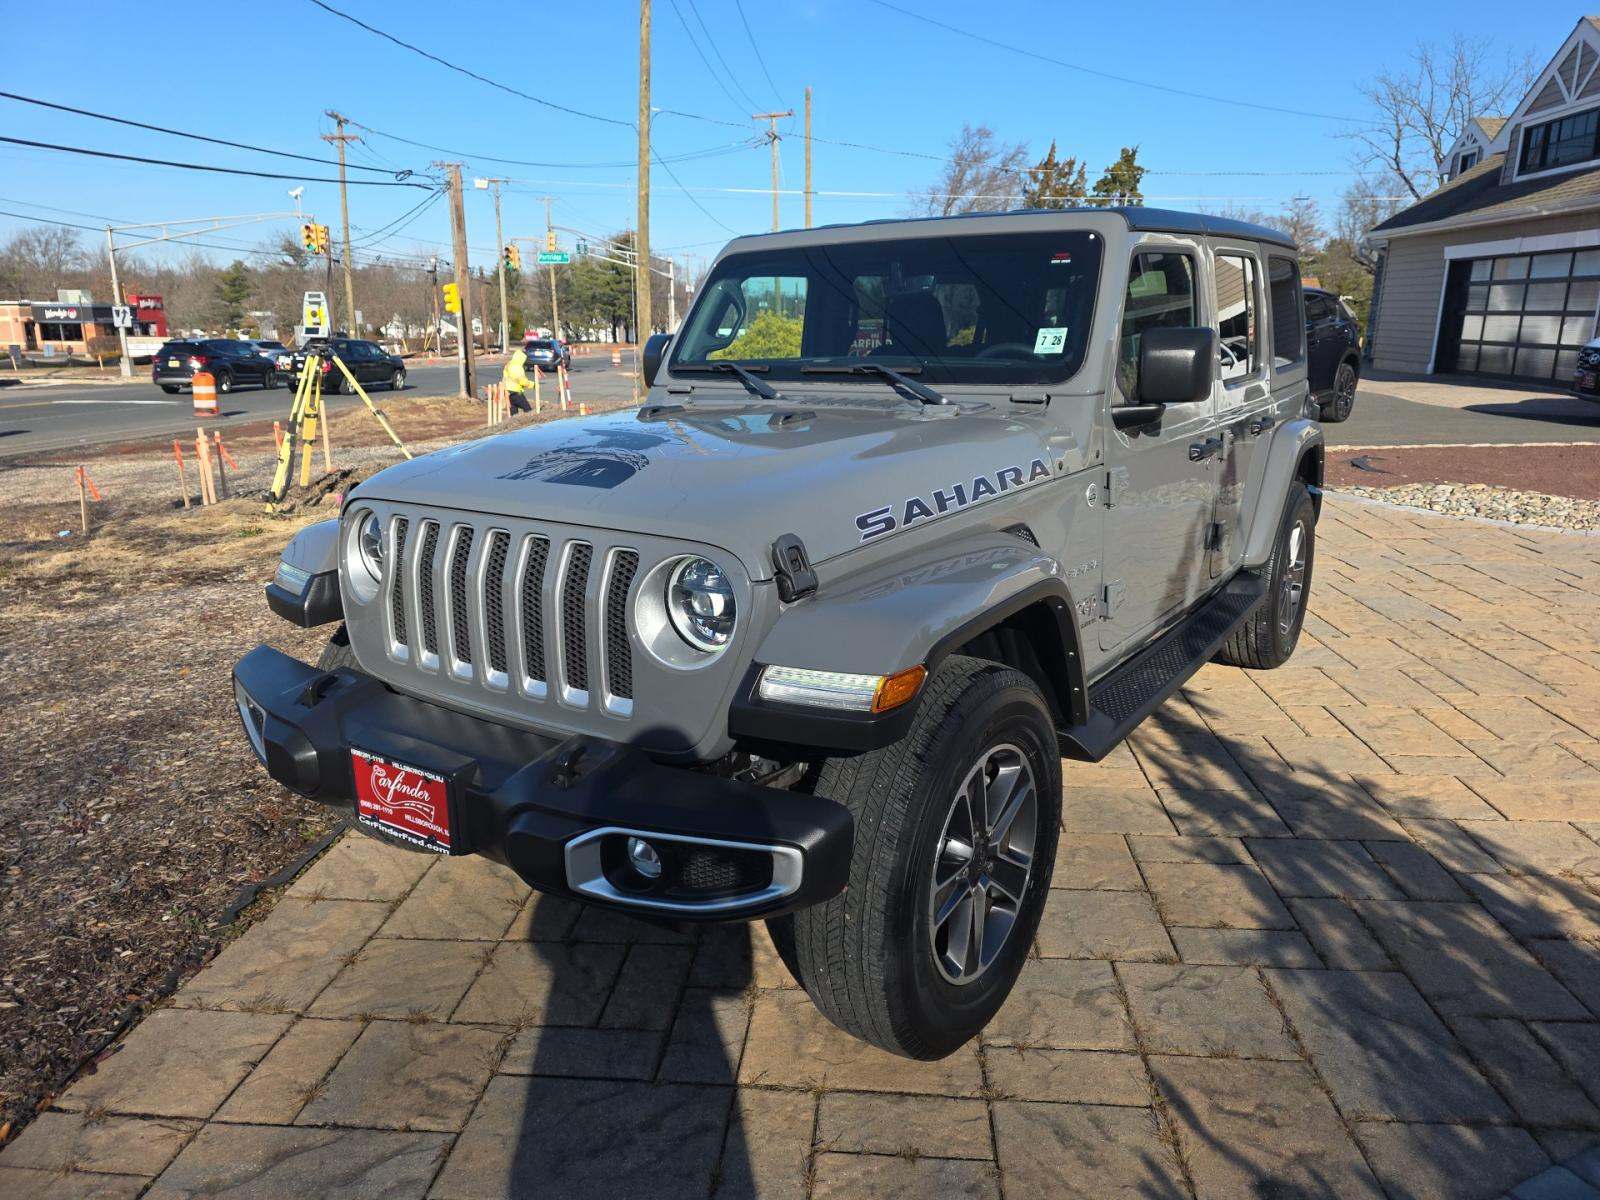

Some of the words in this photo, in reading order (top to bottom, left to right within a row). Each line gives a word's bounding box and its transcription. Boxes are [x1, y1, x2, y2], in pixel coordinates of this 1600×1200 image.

[1041, 335, 1048, 346] 7
[1051, 335, 1063, 346] 28
[855, 458, 1052, 543] SAHARA
[358, 815, 450, 855] CarFinderFred.com
